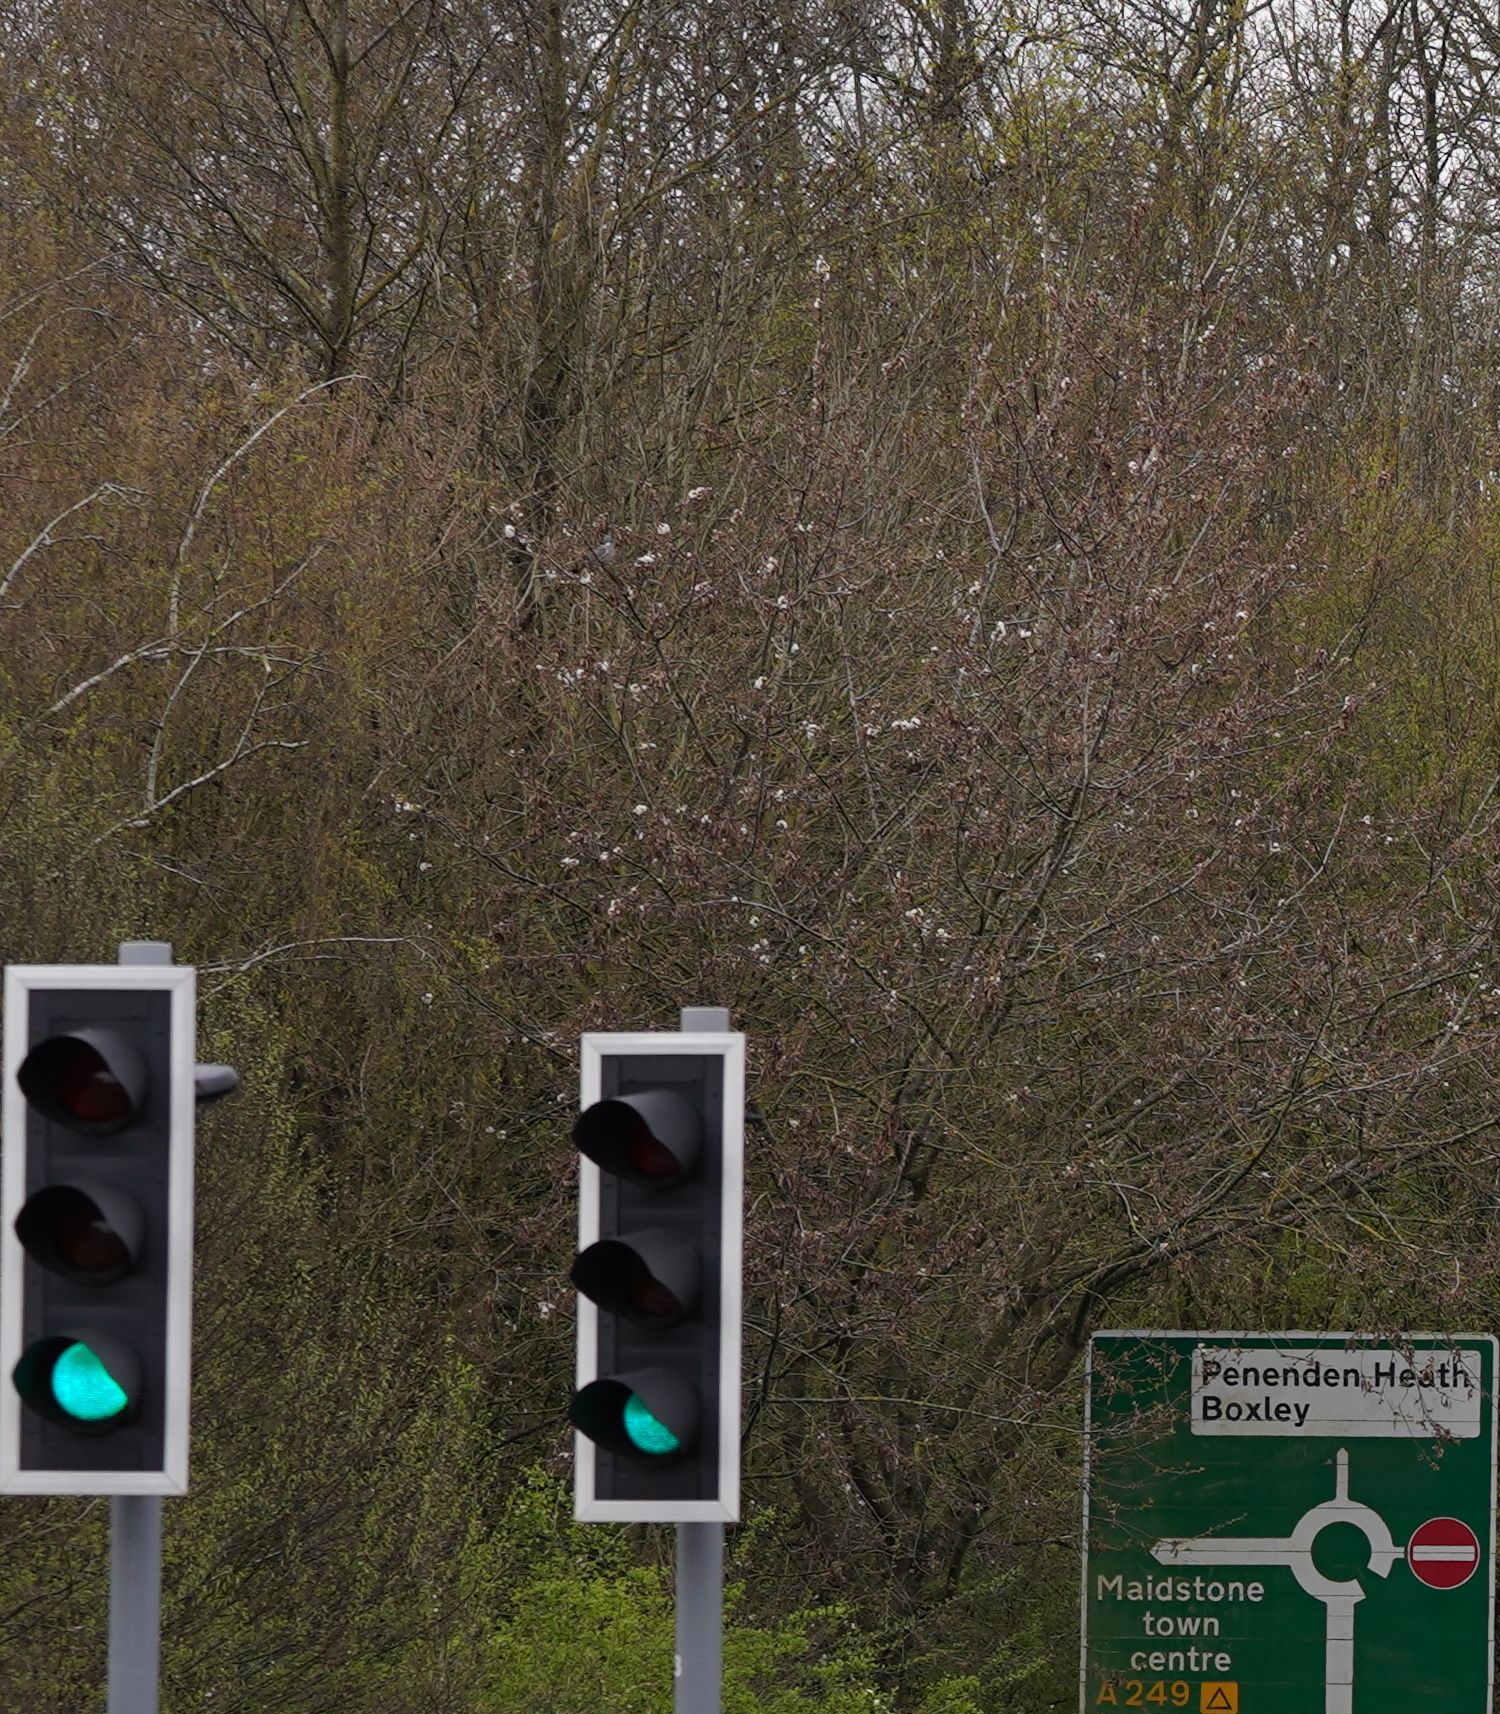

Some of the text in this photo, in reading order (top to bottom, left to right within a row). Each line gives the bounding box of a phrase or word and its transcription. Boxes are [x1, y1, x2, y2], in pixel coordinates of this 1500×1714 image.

[1202, 1358, 1469, 1388] Penenden Heath
[1202, 1396, 1310, 1427] Boxley
[1097, 1575, 1265, 1602] Maidstone
[1142, 1610, 1220, 1637] town
[1131, 1646, 1232, 1672] centre
